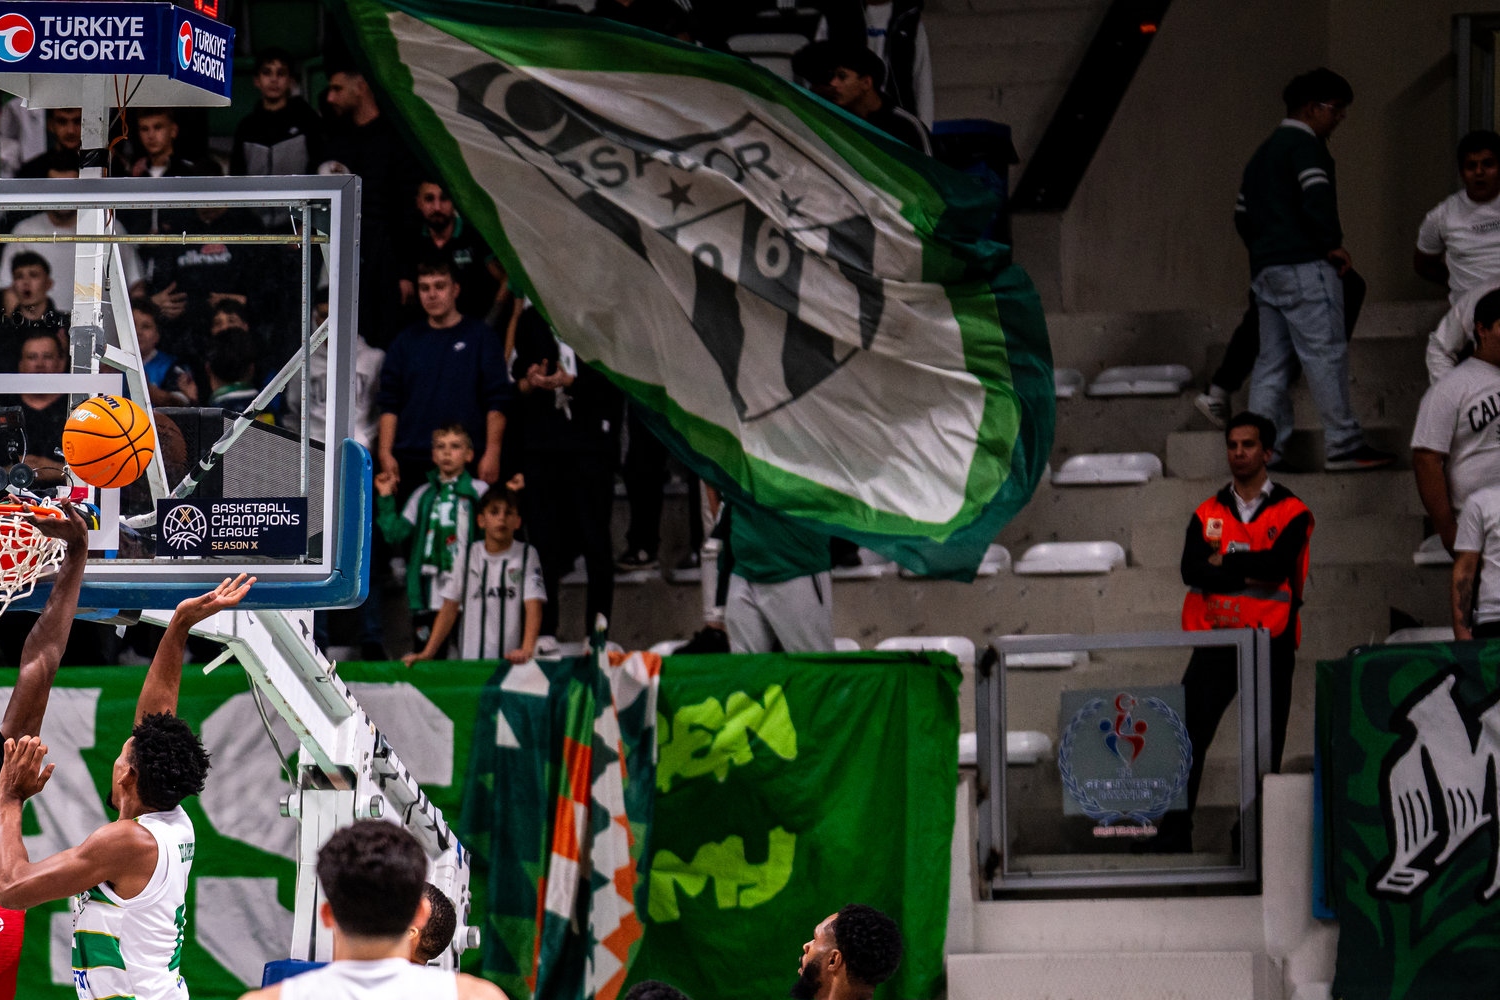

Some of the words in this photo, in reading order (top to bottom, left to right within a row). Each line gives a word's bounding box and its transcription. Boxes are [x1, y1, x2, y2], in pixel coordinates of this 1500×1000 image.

[211, 503, 291, 513] BASKETBALL
[211, 514, 300, 526] CHAMPIONS
[211, 527, 259, 537] LEAGUE
[211, 541, 249, 550] SEASON
[250, 541, 259, 550] X
